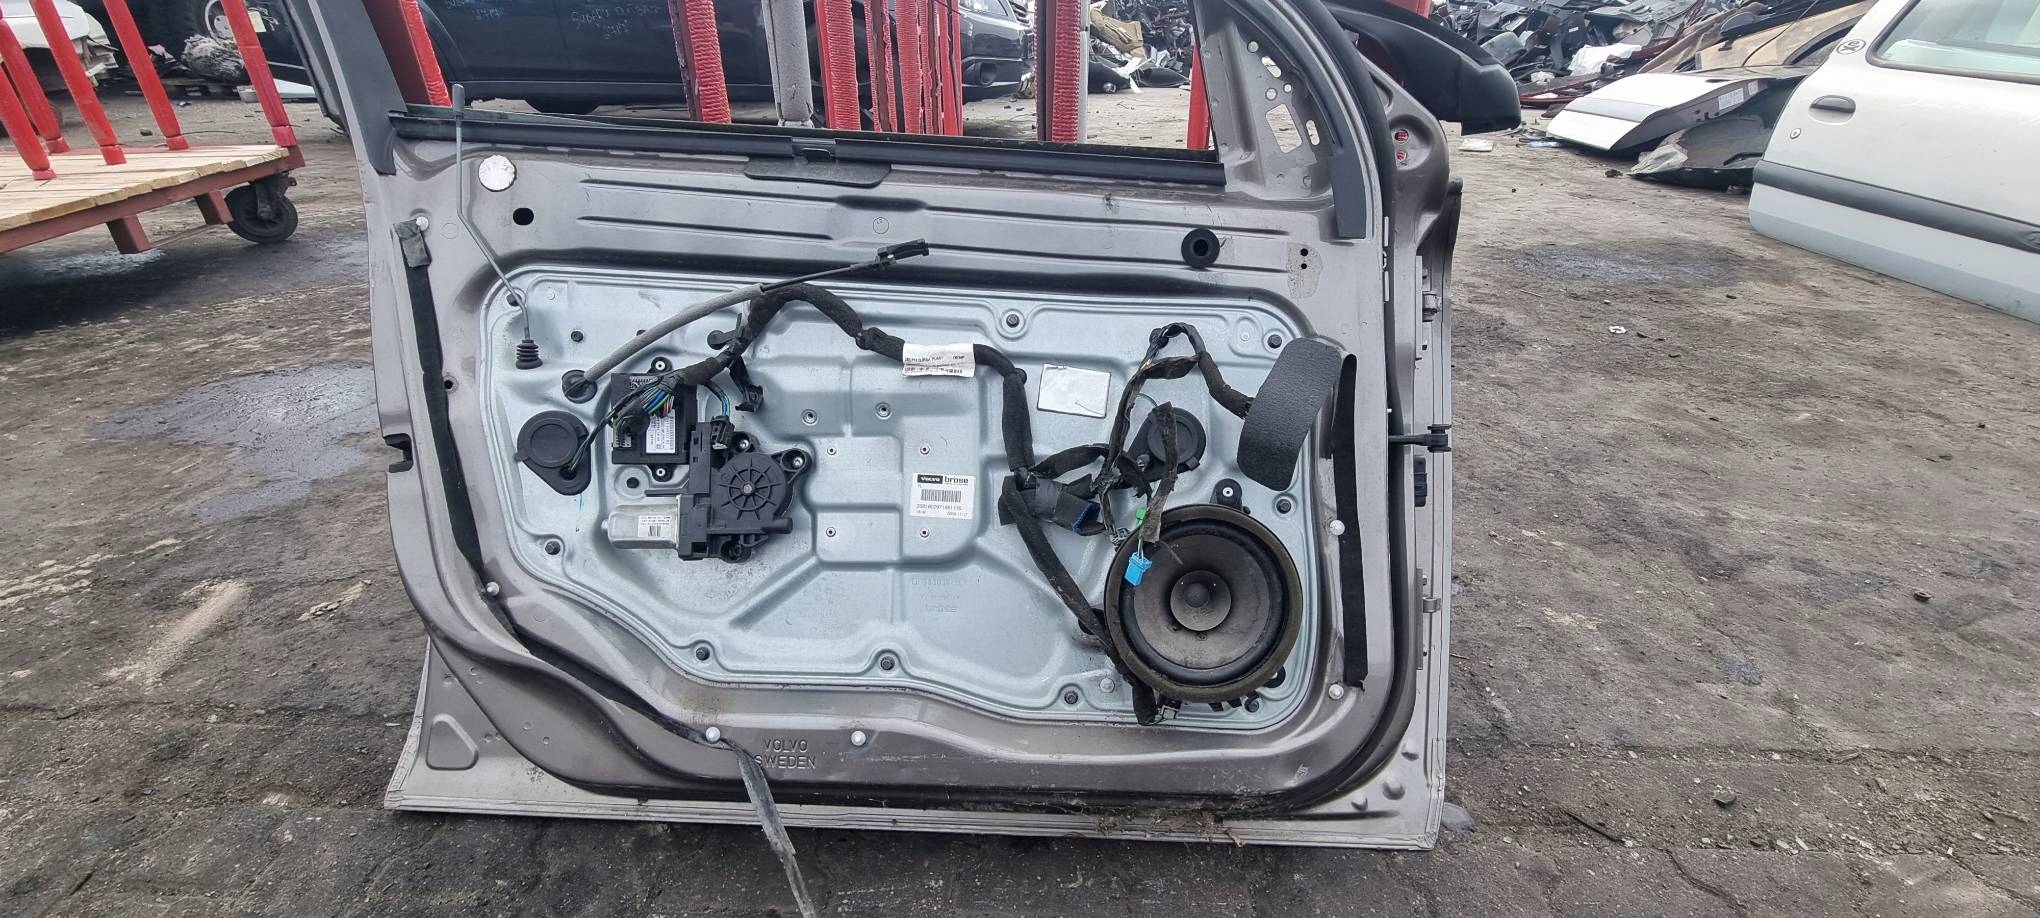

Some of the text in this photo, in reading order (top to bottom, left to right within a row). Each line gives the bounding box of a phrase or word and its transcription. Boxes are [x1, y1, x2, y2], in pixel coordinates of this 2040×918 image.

[944, 475, 969, 484] brose
[764, 738, 808, 753] VOLVO
[754, 754, 817, 770] SWEDEN
